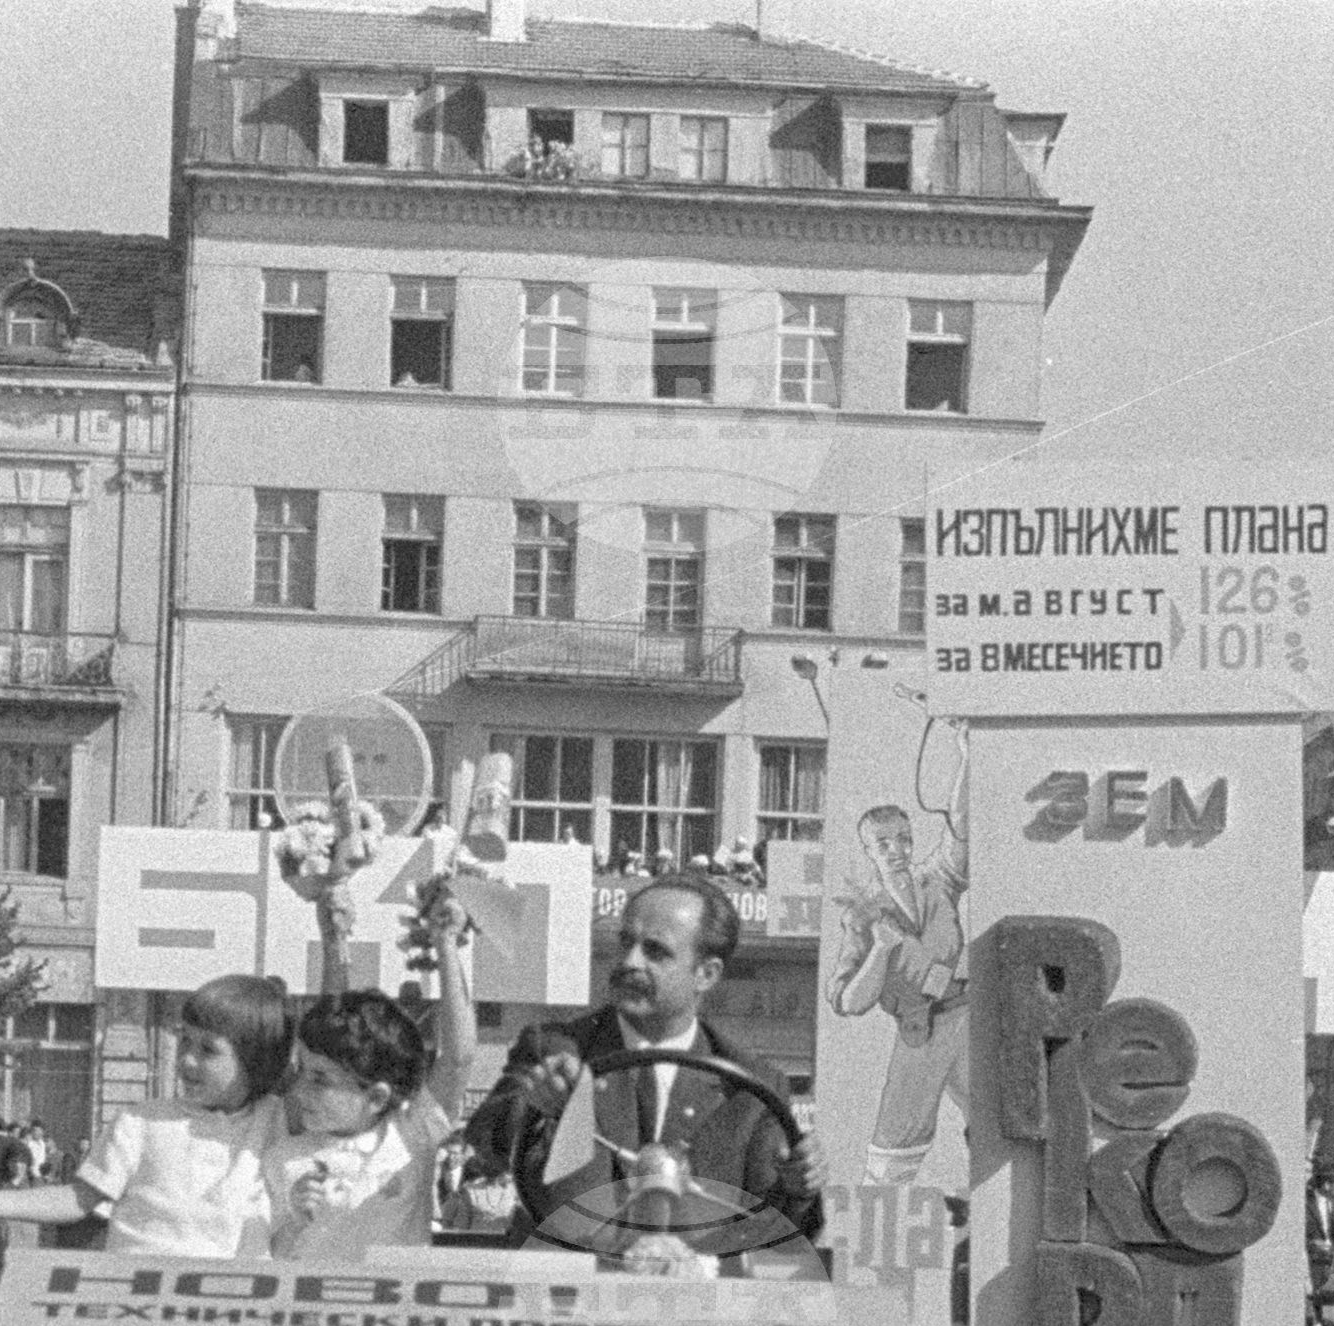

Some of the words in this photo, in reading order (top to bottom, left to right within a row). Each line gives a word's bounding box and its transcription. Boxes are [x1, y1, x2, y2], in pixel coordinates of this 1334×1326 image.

[936, 506, 1180, 556] ИЗПЪЛНИХМЕ
[935, 594, 969, 616] за
[935, 647, 972, 673] за
[1022, 770, 1229, 848] ЗЕМ
